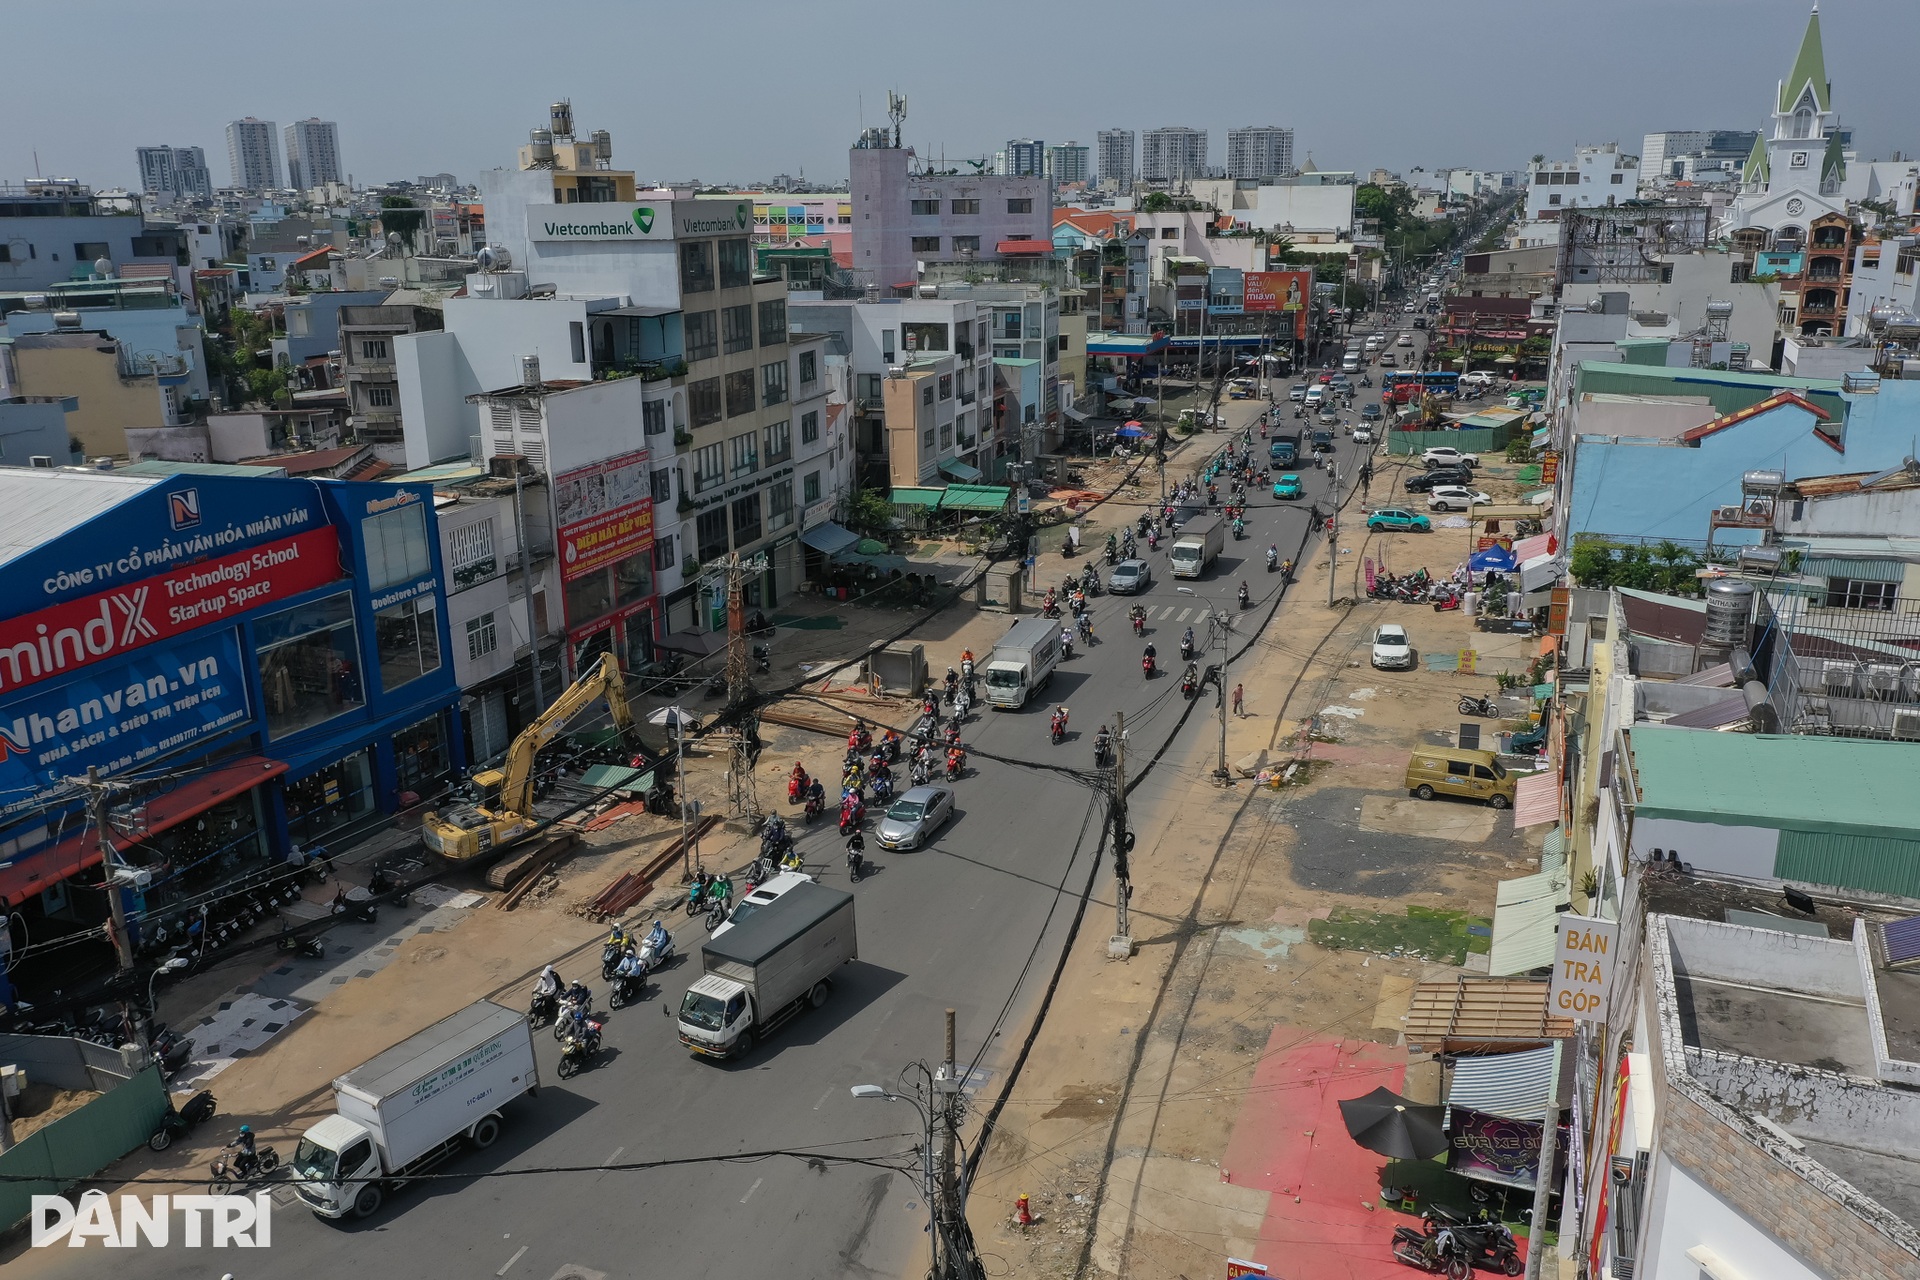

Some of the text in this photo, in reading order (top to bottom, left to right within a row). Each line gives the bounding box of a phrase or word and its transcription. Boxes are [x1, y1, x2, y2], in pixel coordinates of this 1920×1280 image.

[544, 221, 634, 236] Vietcombank
[683, 216, 736, 233] Vietcombank
[576, 531, 598, 550] ĐIỆN
[598, 523, 617, 541] MÁY
[618, 514, 634, 534] BẾP
[633, 510, 651, 528] VIỆT
[43, 507, 309, 594] CÔNG TY CỔ PHẦN VĂN HÓA NHÂN VĂN
[164, 543, 299, 598] Technology School
[168, 580, 271, 625] Startup Space
[371, 588, 412, 610] Bookstore
[416, 578, 437, 594] Mart
[0, 586, 158, 690] mindX
[39, 685, 222, 766] NHÀ SÁCH & SIÊU THỊ TIỆN ÍCH
[562, 699, 589, 725] KOMATSU
[1566, 927, 1608, 955] BÁN
[1563, 959, 1602, 985] TRẢ
[1558, 988, 1601, 1013] GÓP
[1454, 1133, 1491, 1148] SỬA
[1494, 1137, 1520, 1148] XE
